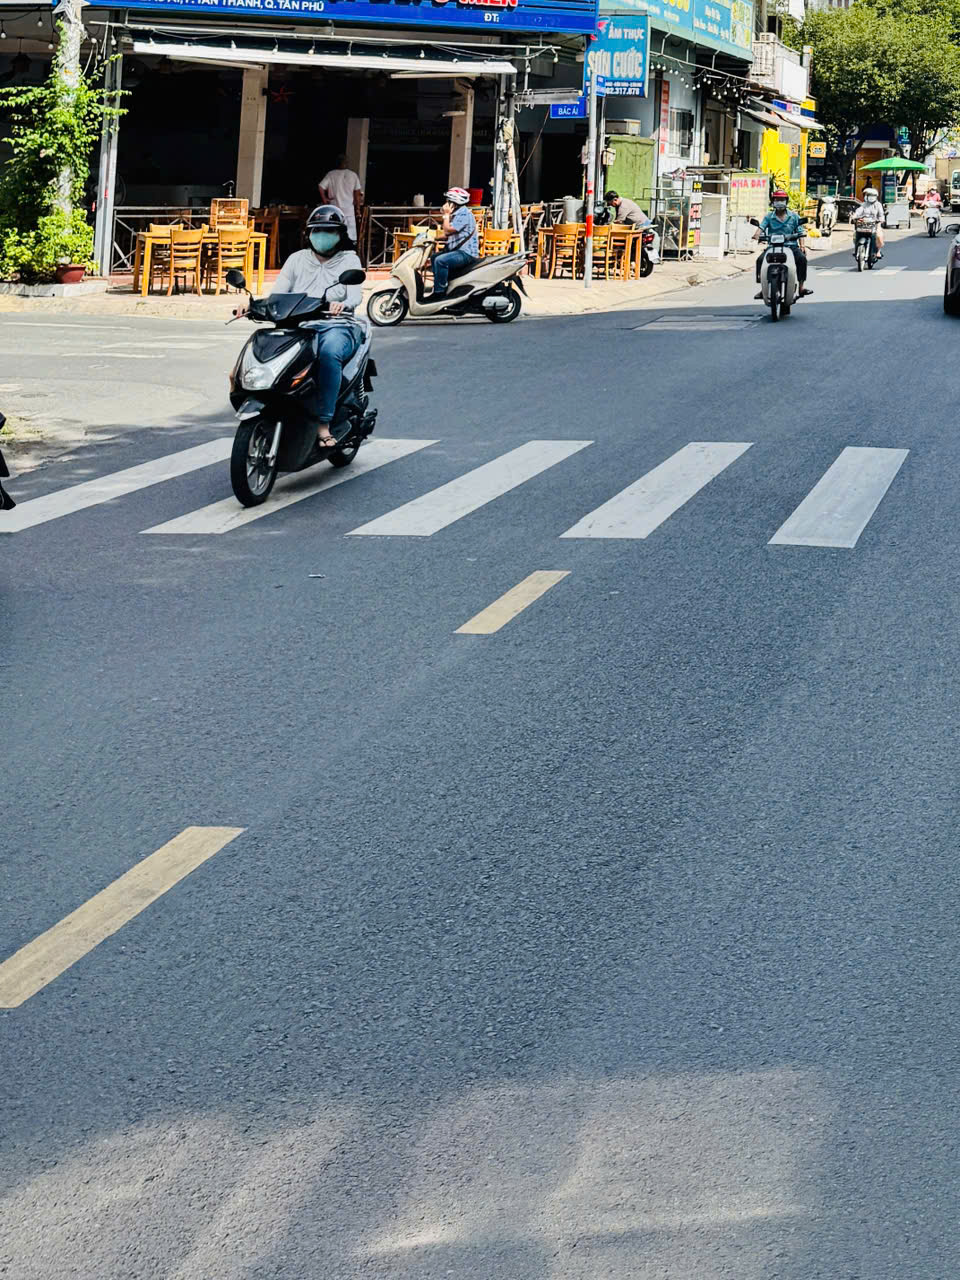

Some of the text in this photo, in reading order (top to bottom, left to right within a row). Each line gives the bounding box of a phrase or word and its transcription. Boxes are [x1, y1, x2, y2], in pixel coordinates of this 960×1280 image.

[302, 0, 325, 12] PHÚ
[484, 13, 500, 23] ĐT:
[558, 105, 579, 115] BÁC ÁI
